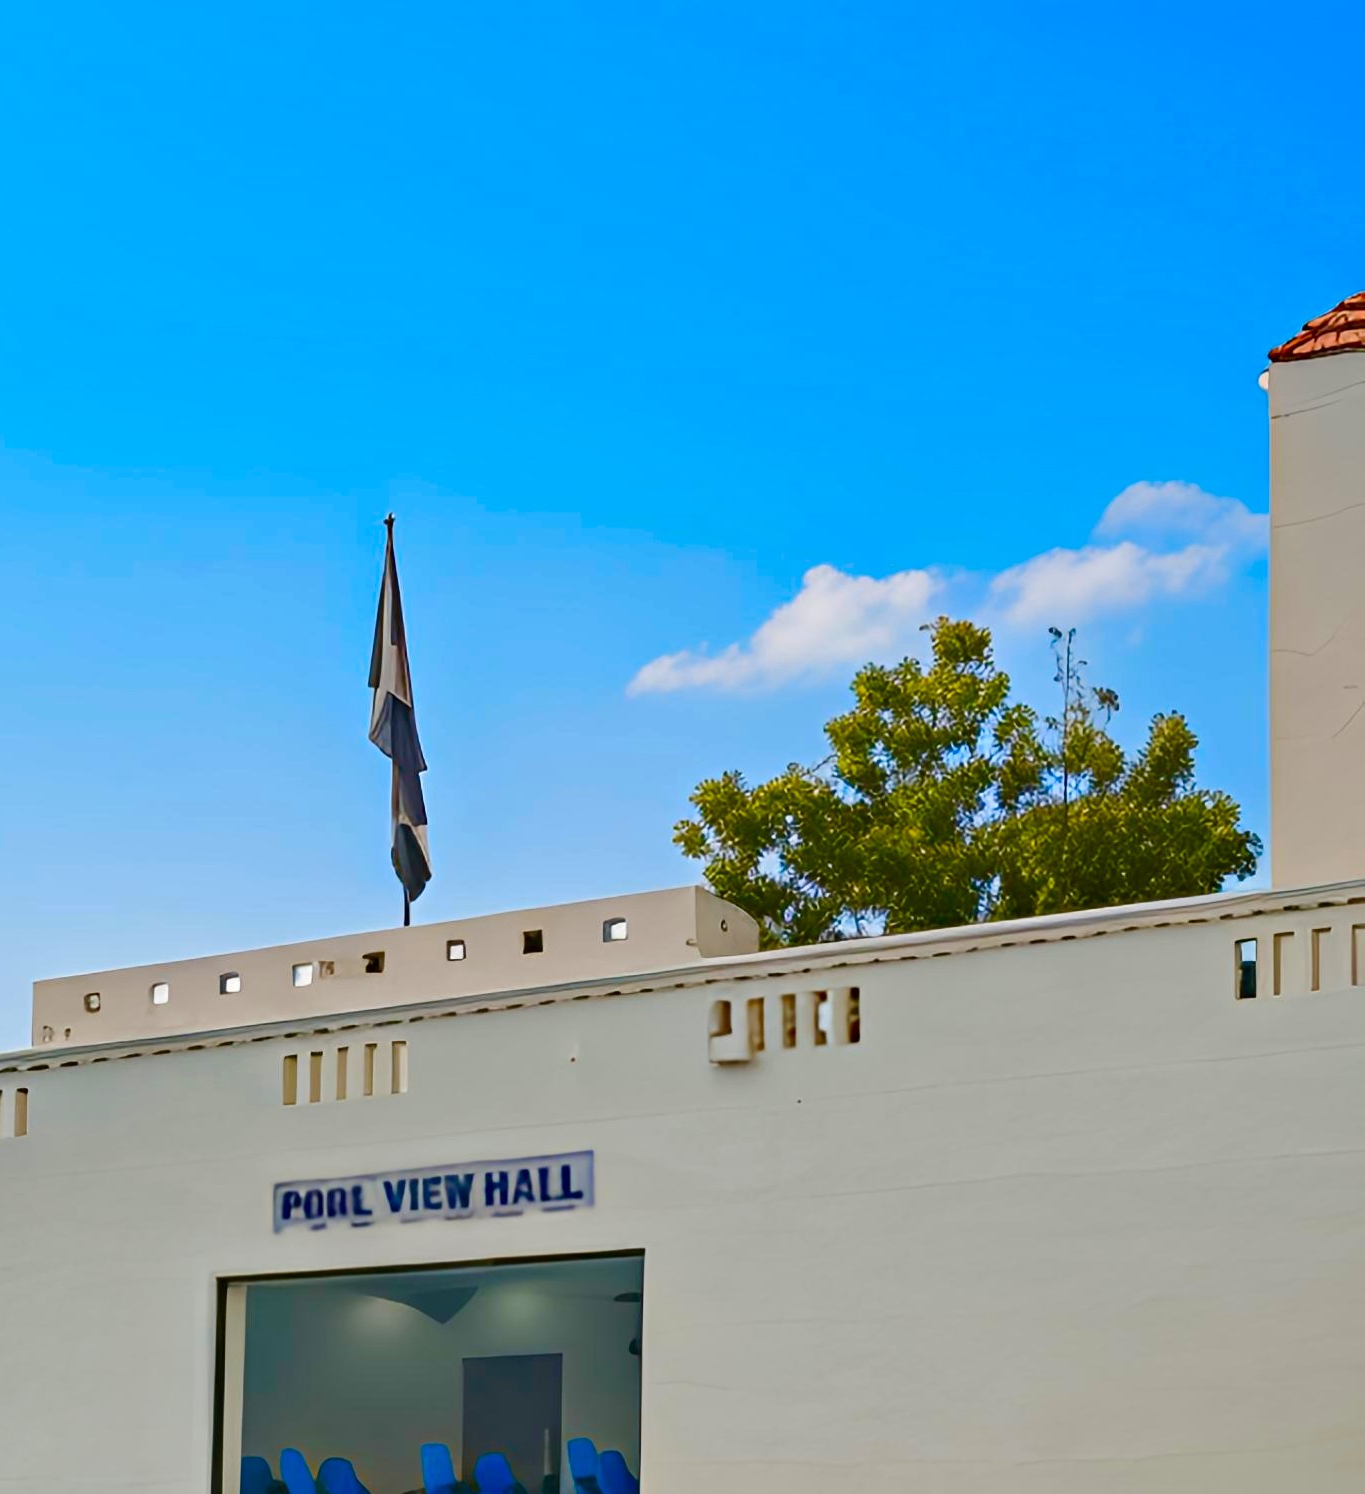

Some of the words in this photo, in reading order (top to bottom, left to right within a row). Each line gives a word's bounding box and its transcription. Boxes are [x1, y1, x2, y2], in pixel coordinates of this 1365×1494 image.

[281, 1185, 373, 1220] POOL
[383, 1173, 475, 1213] VIEW
[484, 1165, 584, 1206] HALL
